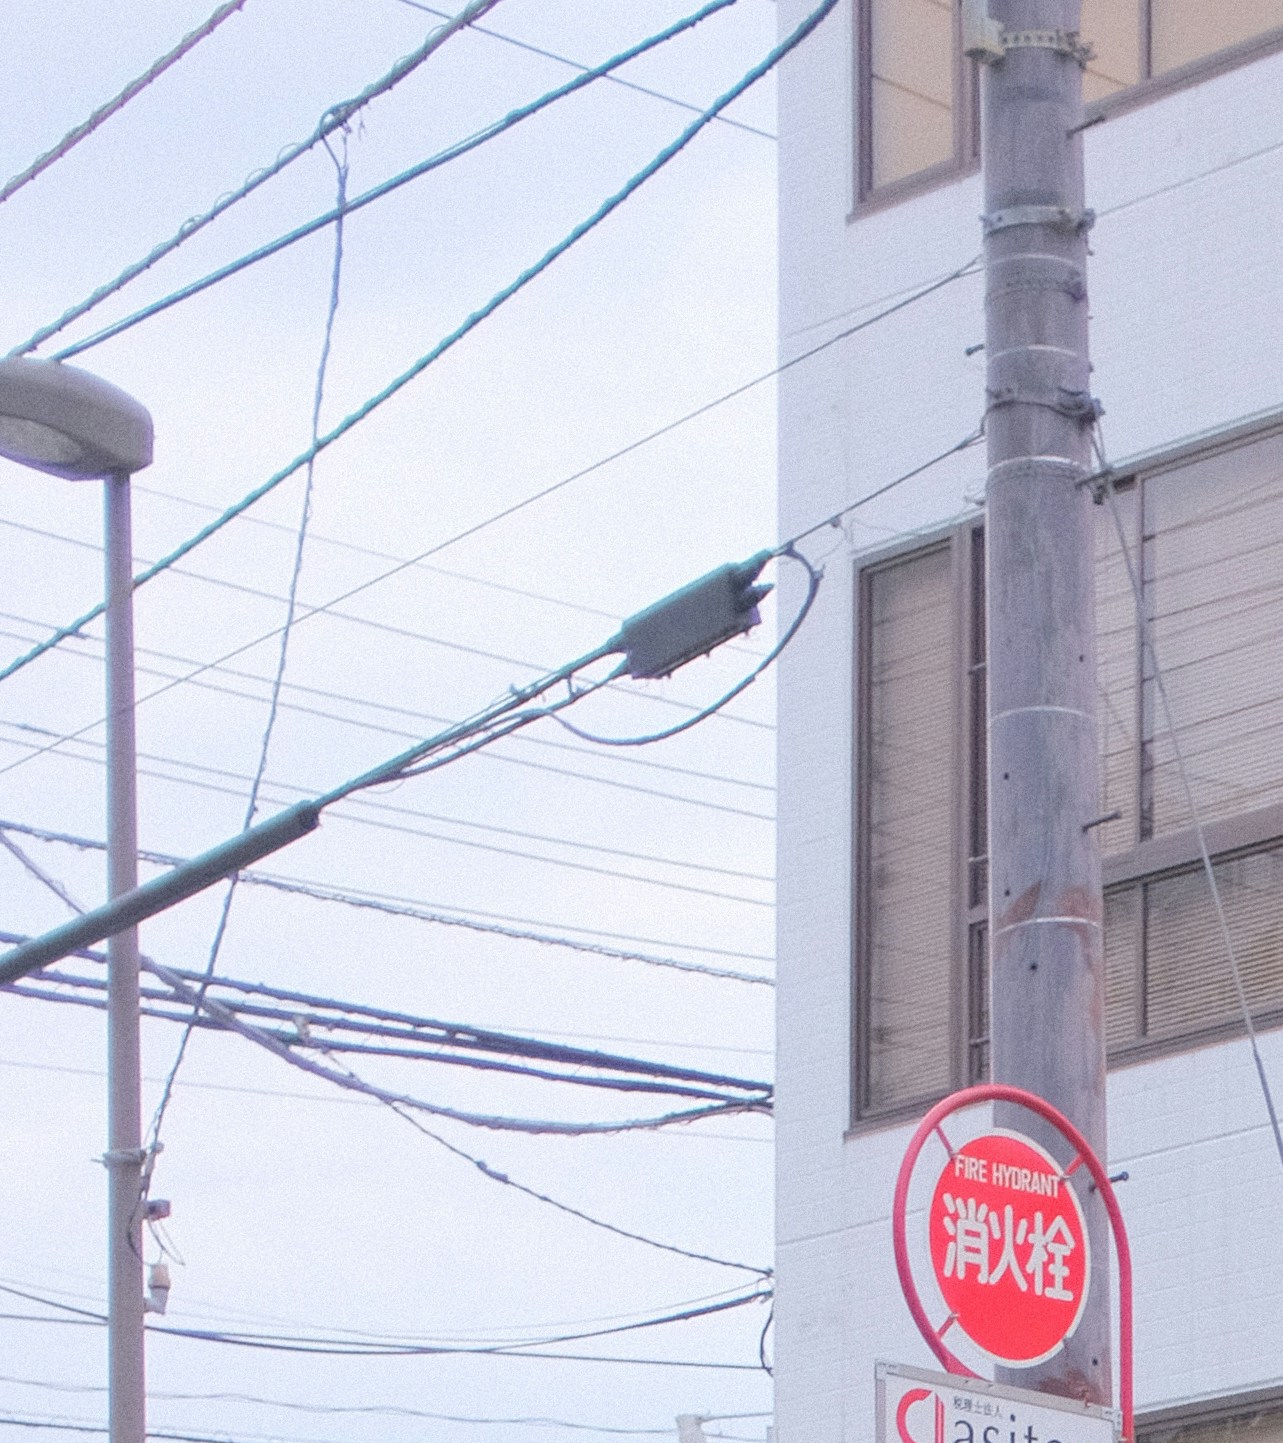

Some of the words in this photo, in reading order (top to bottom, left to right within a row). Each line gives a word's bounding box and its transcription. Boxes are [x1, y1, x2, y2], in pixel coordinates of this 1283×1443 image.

[953, 1154, 988, 1184] FIRE
[992, 1162, 1060, 1199] HYDRANT
[942, 1192, 1076, 1302] 消火栓
